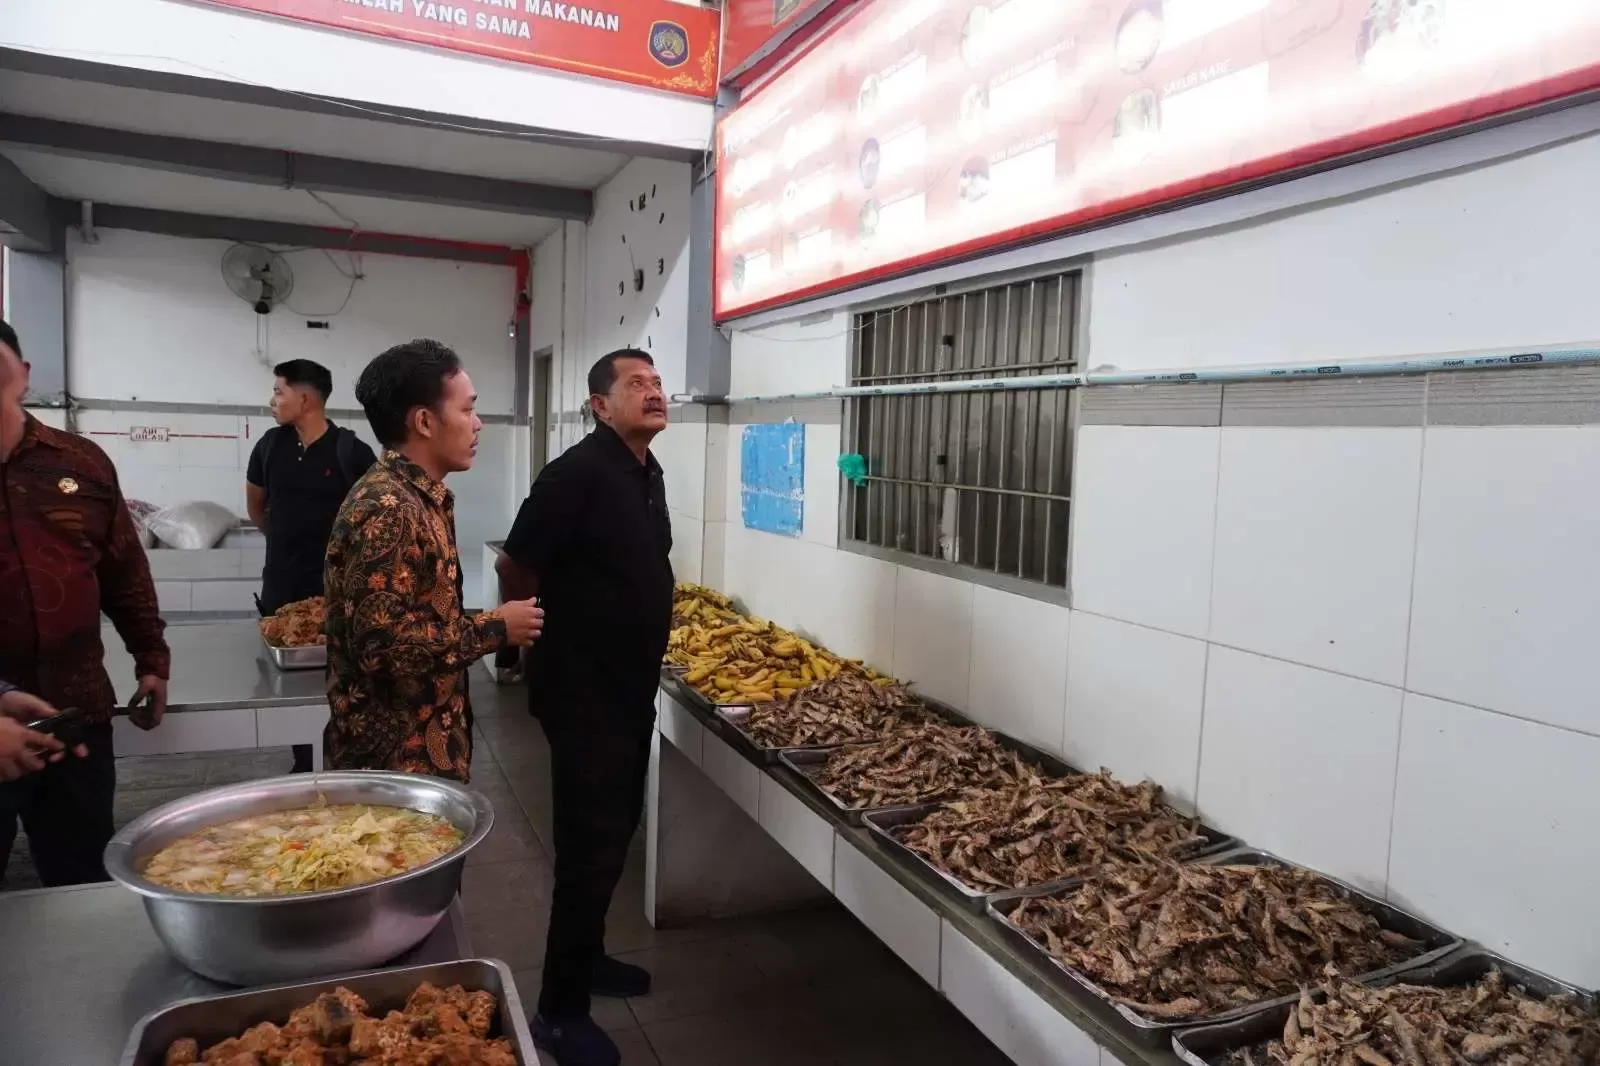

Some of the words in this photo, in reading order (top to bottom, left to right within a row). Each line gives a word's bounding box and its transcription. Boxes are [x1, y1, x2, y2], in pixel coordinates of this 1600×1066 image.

[412, 1, 468, 25] YANG
[476, 12, 532, 39] SAMA
[525, 0, 620, 32] MAKANAN
